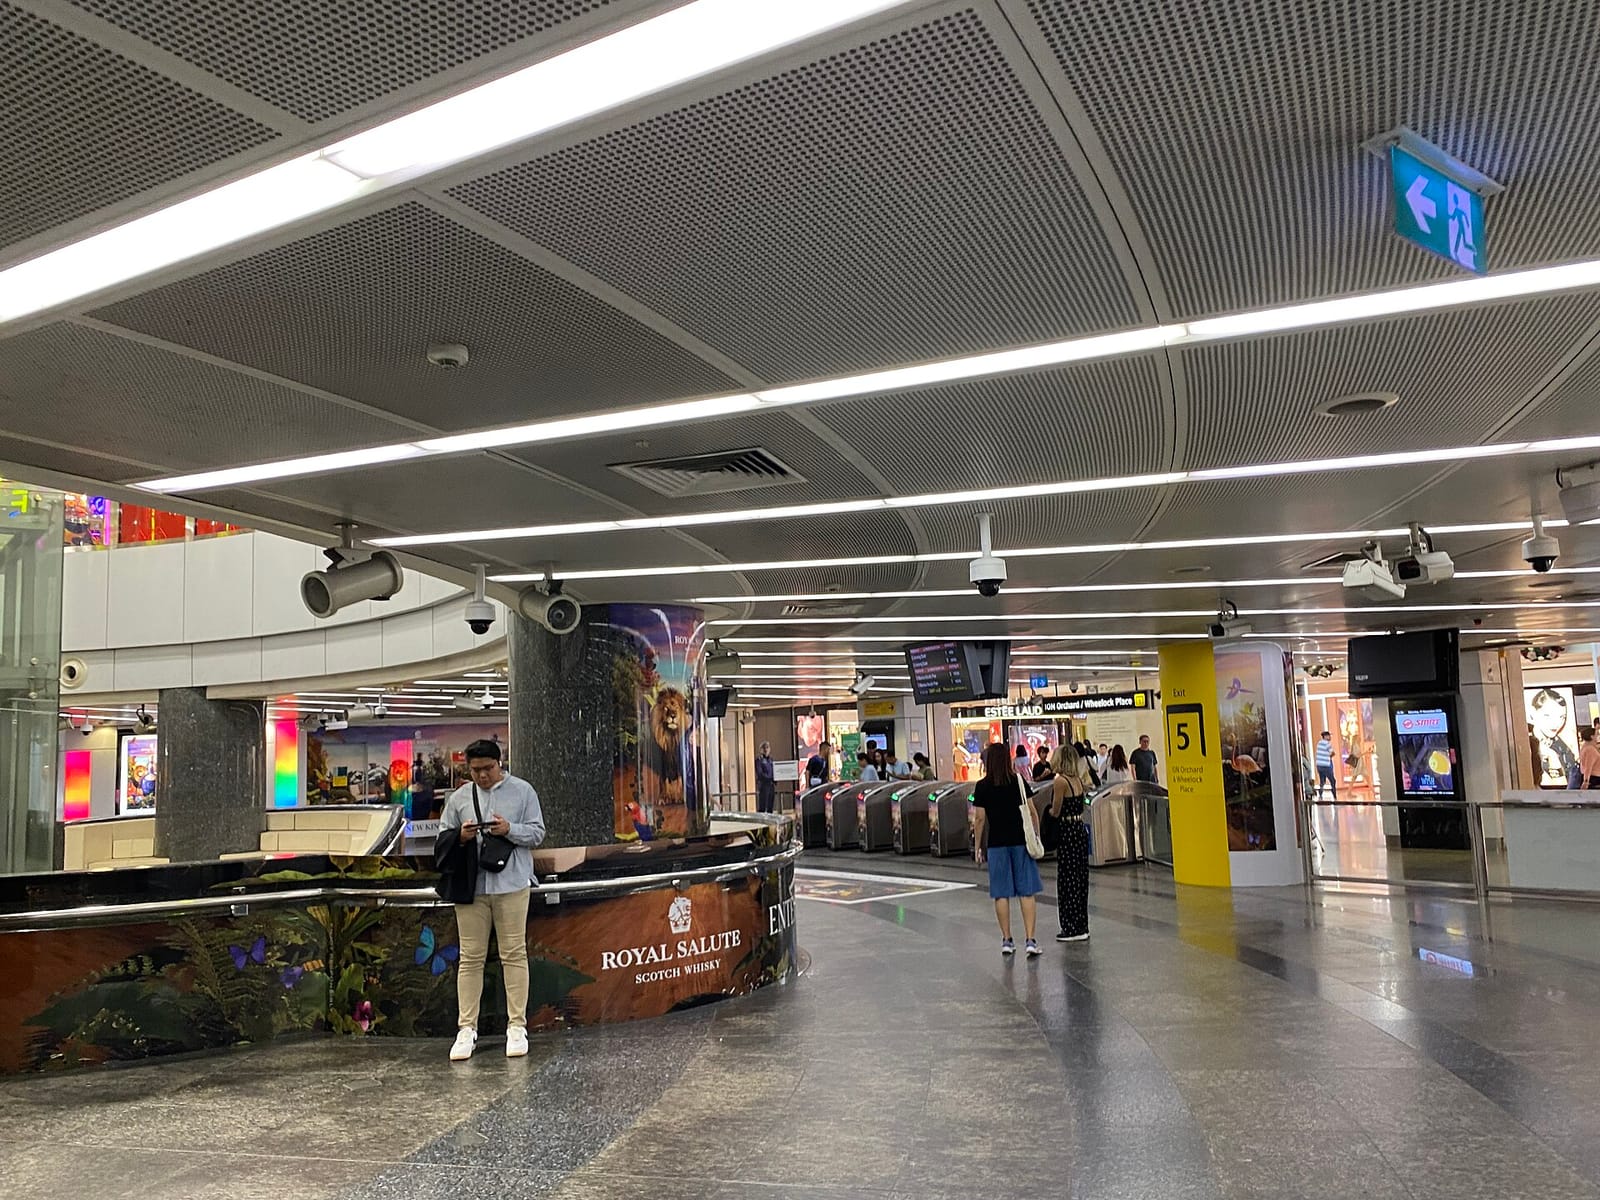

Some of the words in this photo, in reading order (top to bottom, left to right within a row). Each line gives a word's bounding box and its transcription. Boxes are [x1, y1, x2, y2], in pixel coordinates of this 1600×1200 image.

[1172, 688, 1186, 698] Exit
[1044, 702, 1056, 712] ION
[1056, 700, 1080, 711] Orchard
[1084, 697, 1115, 709] Wheelock
[1115, 696, 1133, 707] Place
[1176, 722, 1191, 751] 5
[1180, 765, 1204, 774] Orchard
[405, 823, 424, 832] NEW
[601, 943, 673, 970] ROYAL
[677, 929, 741, 958] SALUTE
[635, 966, 681, 984] SCOTCH
[684, 958, 721, 975] WHISKY
